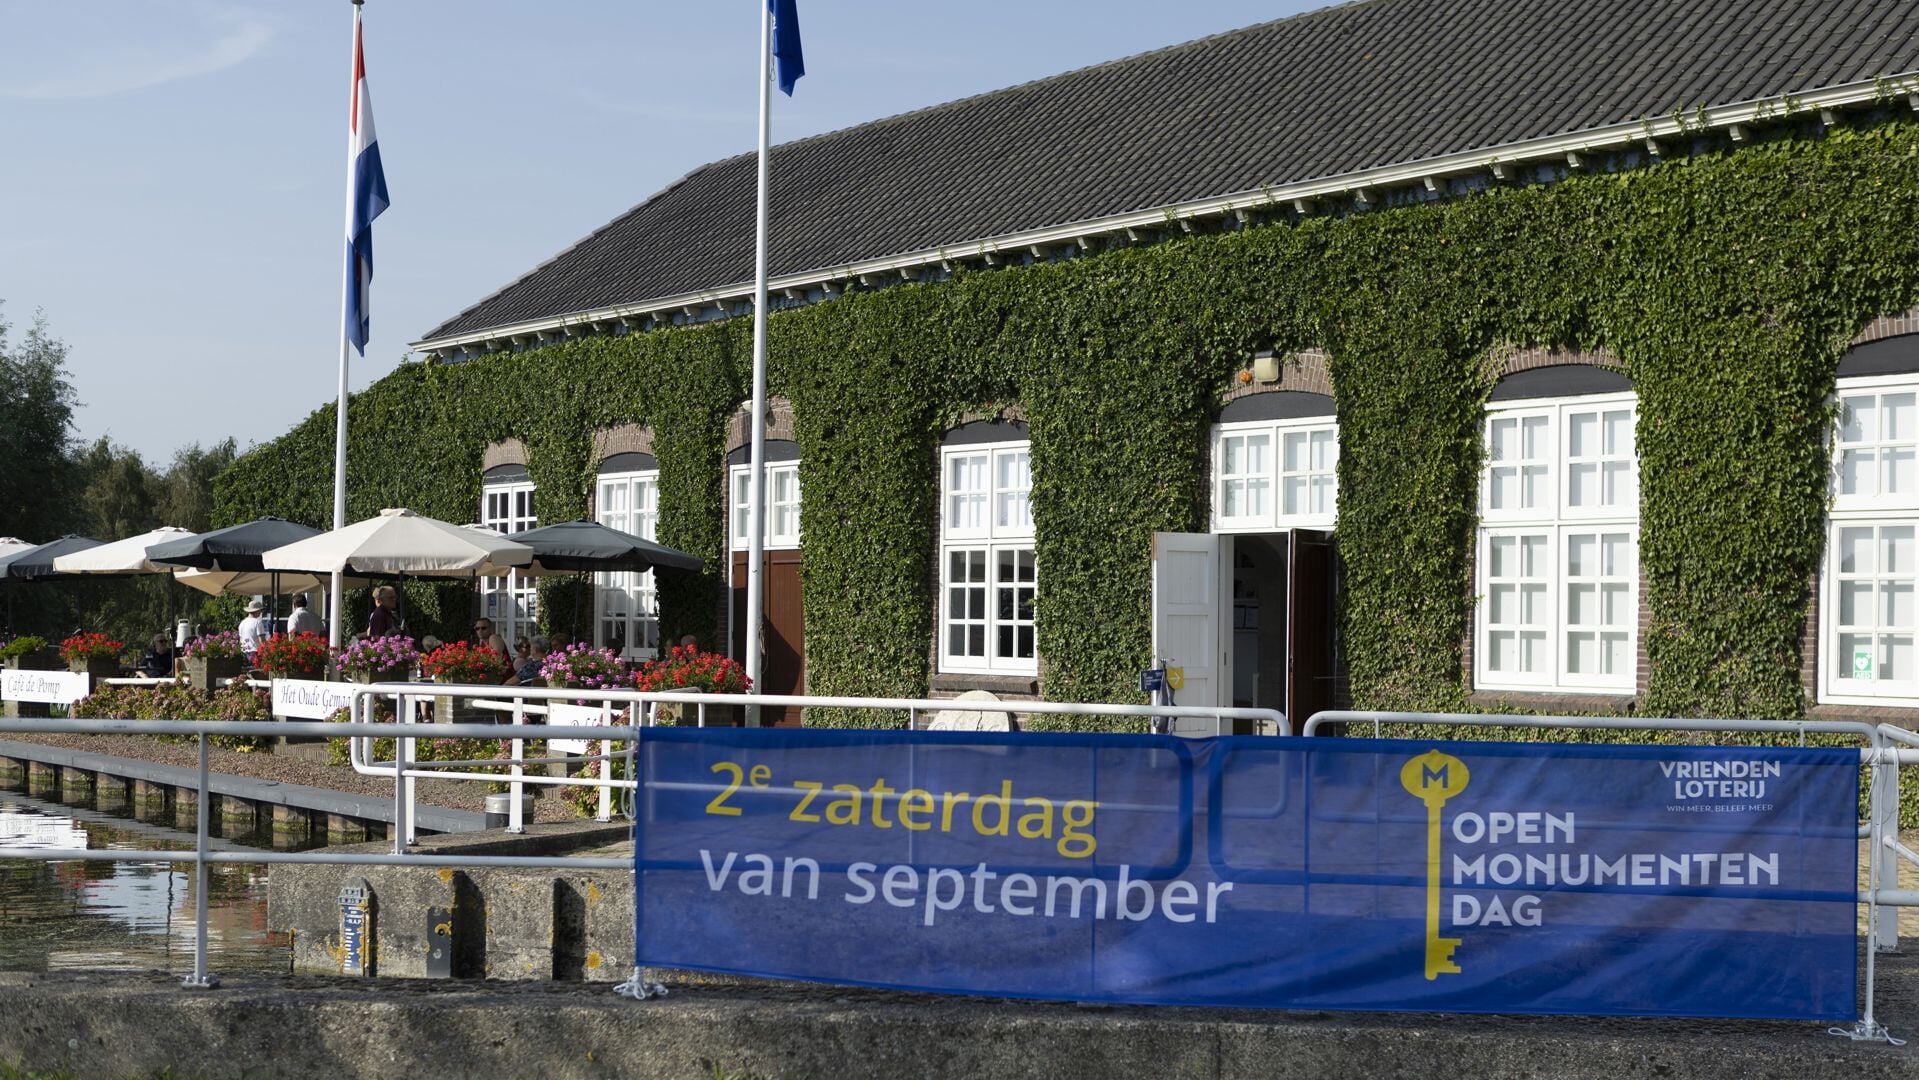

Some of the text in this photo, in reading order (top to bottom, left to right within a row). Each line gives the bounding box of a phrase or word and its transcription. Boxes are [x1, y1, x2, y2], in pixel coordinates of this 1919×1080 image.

[8, 674, 61, 700] Café de Pomp
[281, 684, 296, 704] Het
[298, 684, 320, 706] Oude
[1659, 760, 1781, 778] VRIENDEN
[1675, 780, 1766, 799] LOTERIJ
[789, 778, 1099, 859] zaterdag
[1715, 804, 1746, 812] BELEEF
[1749, 804, 1773, 812] MEER
[1452, 812, 1575, 844] OPEN
[1453, 853, 1779, 886] MONUMENTEN
[700, 849, 1233, 926] van september
[1453, 895, 1543, 927] DAG
